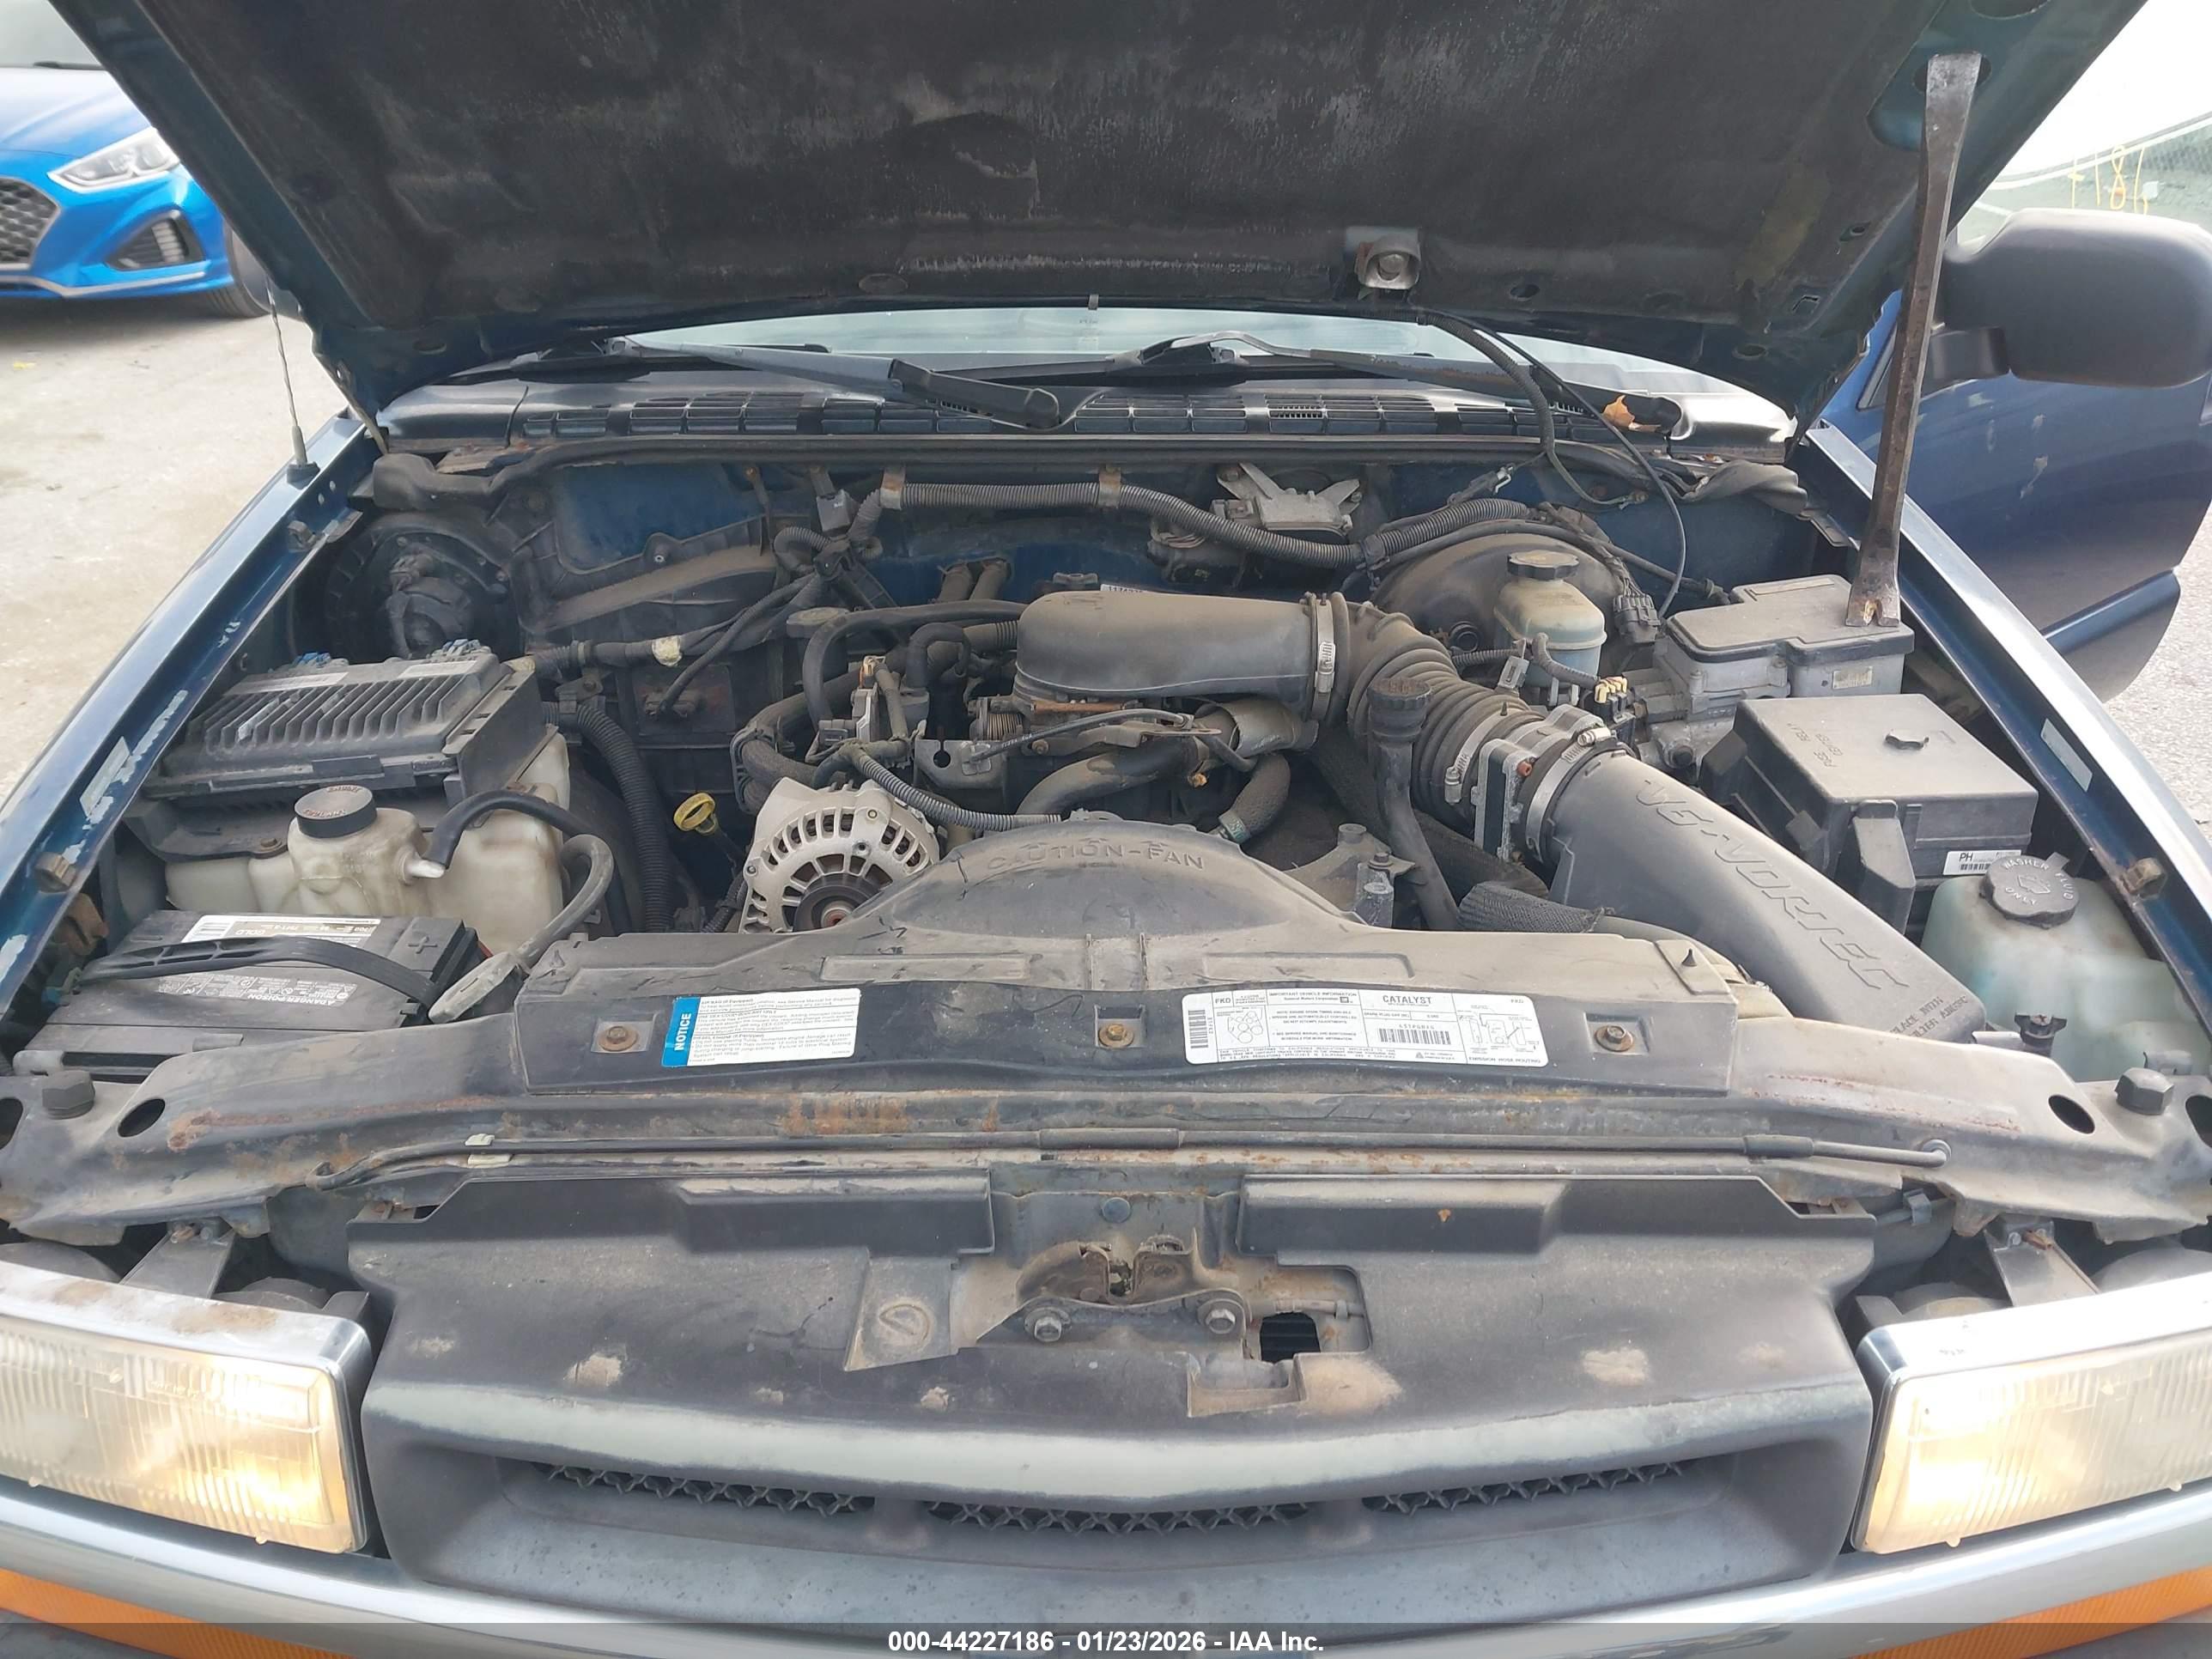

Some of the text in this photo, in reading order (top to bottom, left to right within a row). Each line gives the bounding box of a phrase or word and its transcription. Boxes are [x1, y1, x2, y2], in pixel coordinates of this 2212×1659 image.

[1960, 852, 1973, 862] PH
[2003, 858, 2074, 906] WASHER FLUID ONLY
[1382, 995, 1432, 1004] CATALYST
[674, 1012, 692, 1051] NOTICE
